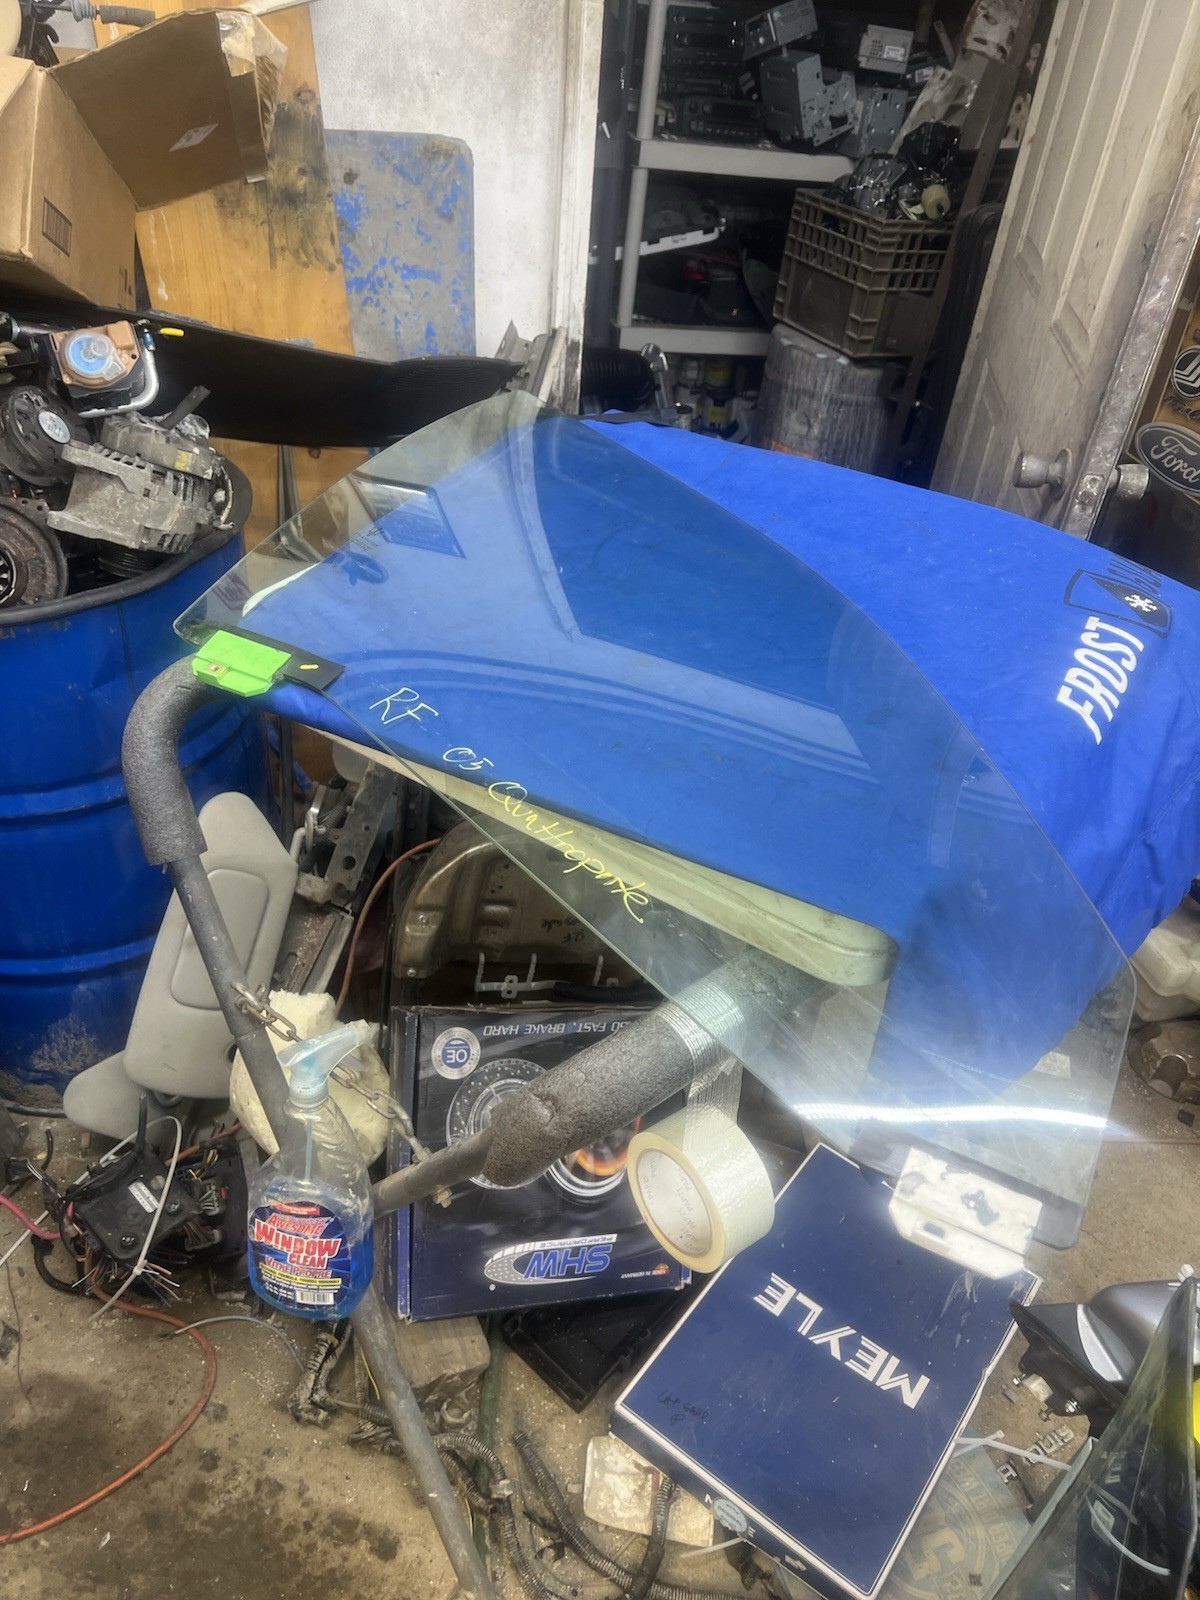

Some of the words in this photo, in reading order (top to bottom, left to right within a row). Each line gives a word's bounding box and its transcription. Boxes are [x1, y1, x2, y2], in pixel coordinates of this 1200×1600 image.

[1150, 435, 1200, 484] Ford
[1056, 616, 1145, 745] FROST
[369, 687, 439, 725] RF
[443, 747, 494, 771] 05
[482, 1024, 520, 1037] HARD
[524, 1022, 565, 1035] BRAKE
[446, 1048, 468, 1064] OE
[254, 1218, 342, 1259] WINDOW
[540, 1235, 614, 1249] PERFORMANCE
[287, 1252, 328, 1269] CLEAN
[523, 1244, 613, 1279] SHW
[292, 1265, 333, 1278] PROPRE
[619, 1271, 645, 1279] GERMANY
[753, 1272, 931, 1409] MEYLE
